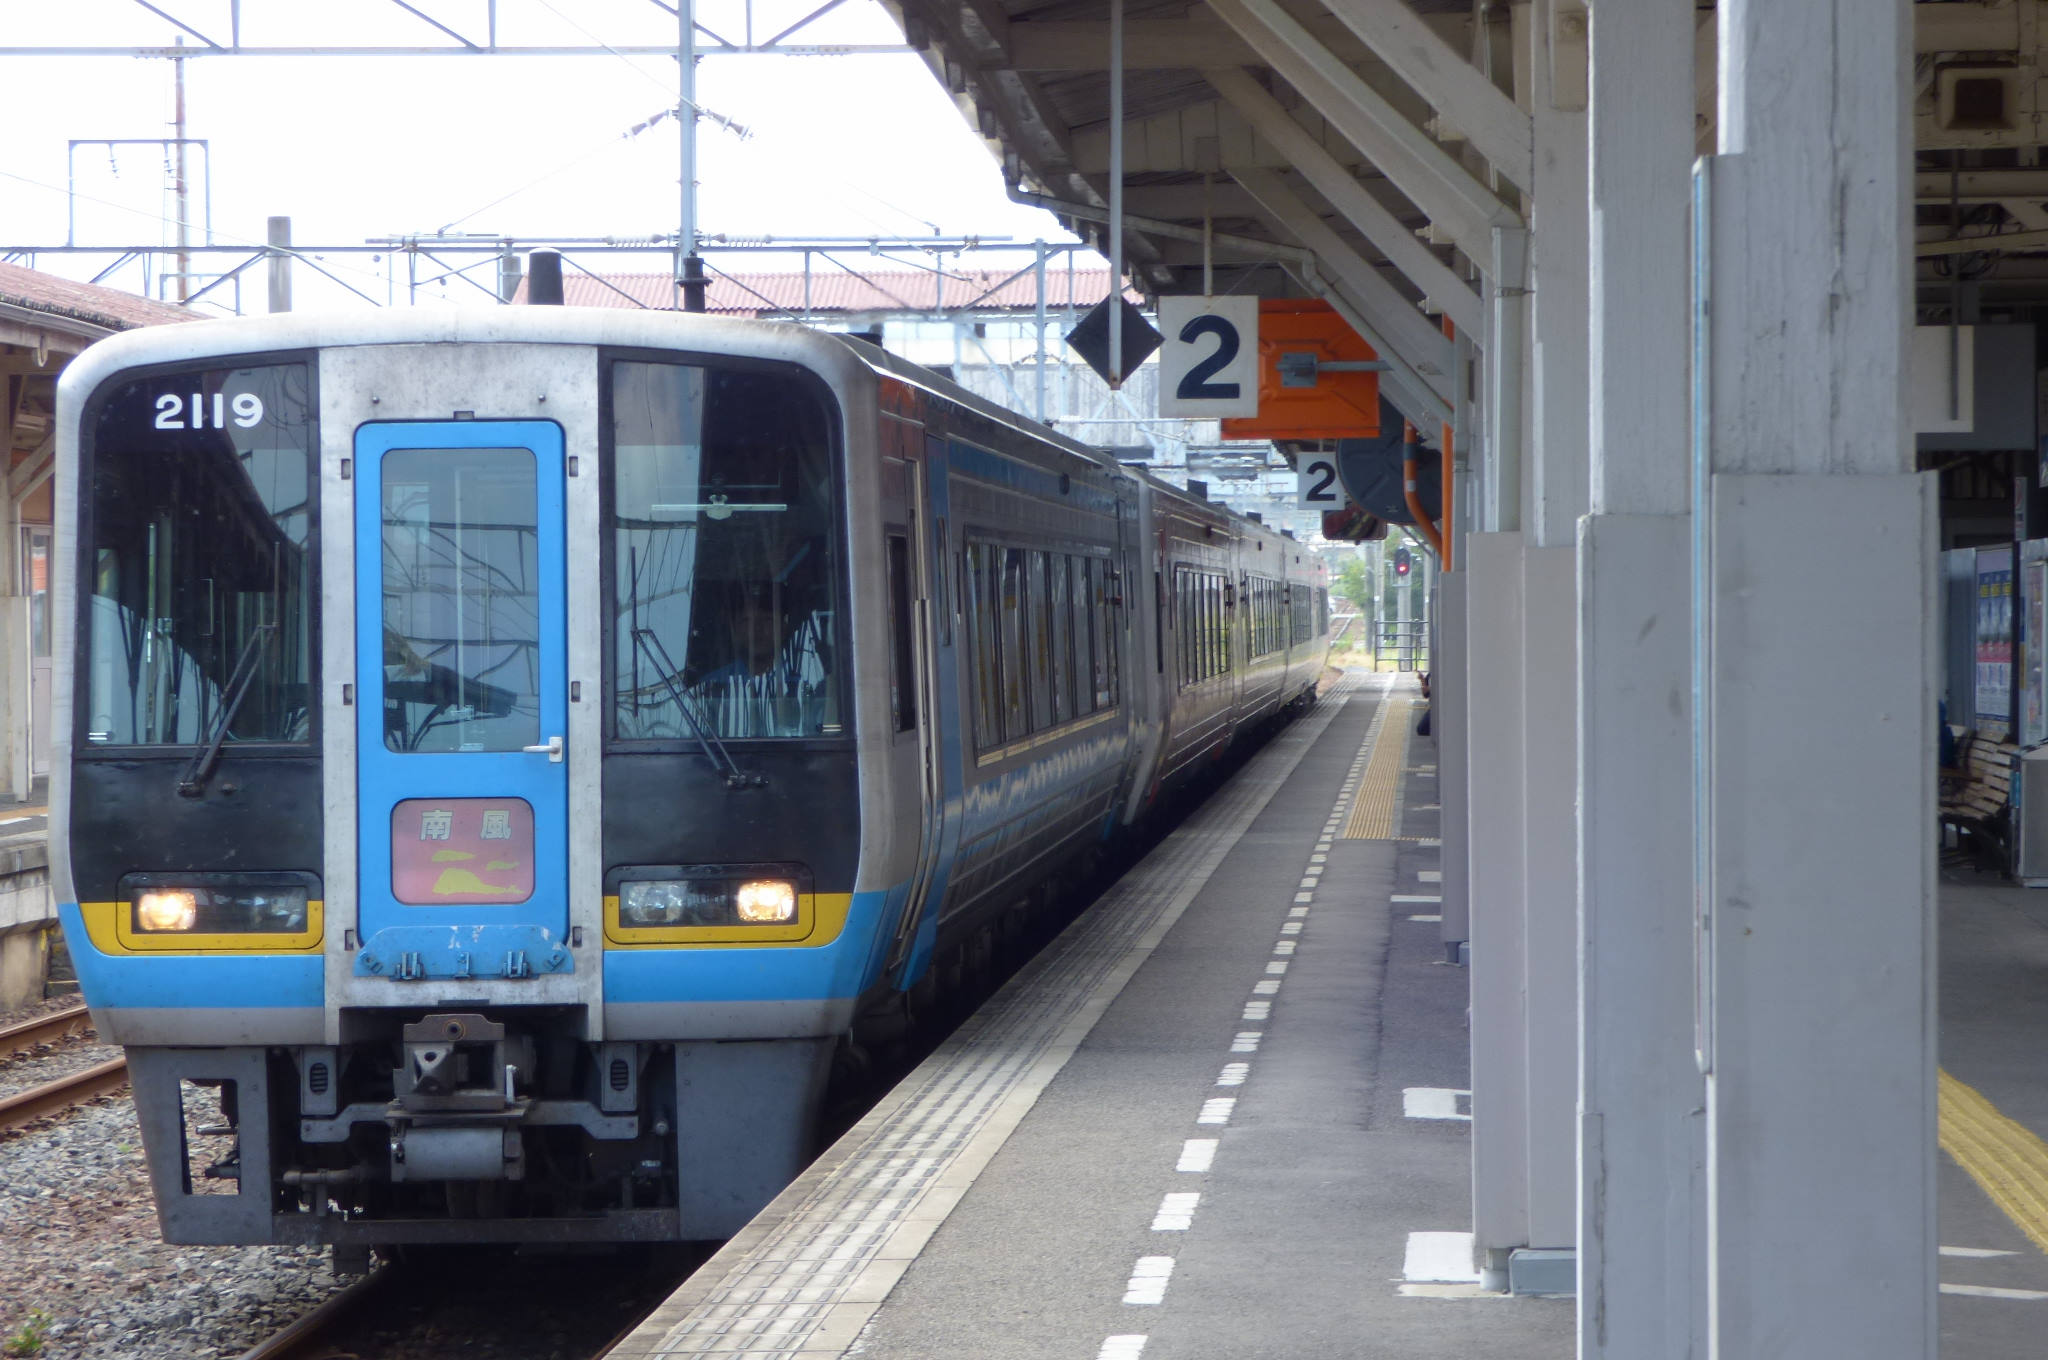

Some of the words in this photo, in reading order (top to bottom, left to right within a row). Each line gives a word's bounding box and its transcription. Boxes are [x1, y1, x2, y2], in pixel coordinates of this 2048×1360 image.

[1176, 315, 1240, 399] 2
[155, 392, 264, 429] 2119
[1306, 461, 1336, 501] 2
[420, 809, 511, 840] 南風
